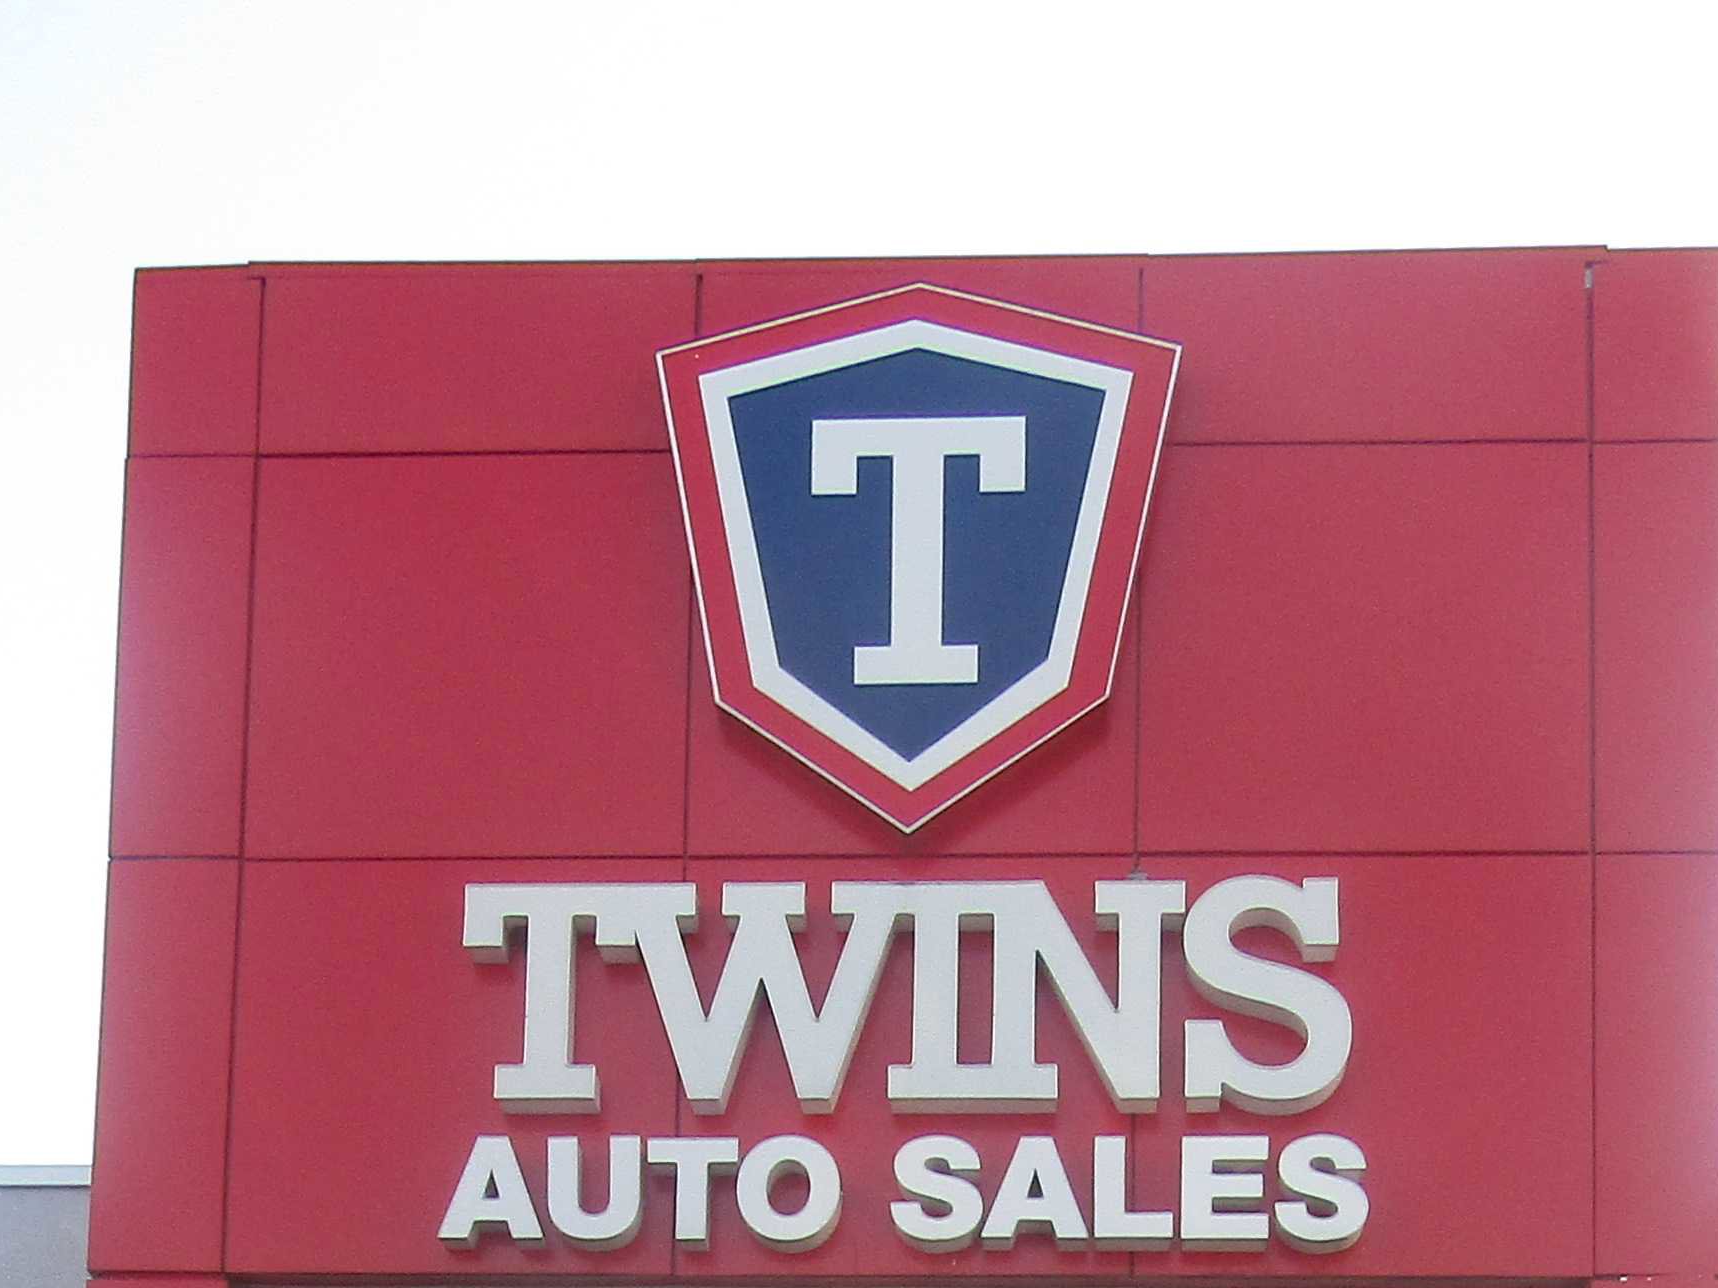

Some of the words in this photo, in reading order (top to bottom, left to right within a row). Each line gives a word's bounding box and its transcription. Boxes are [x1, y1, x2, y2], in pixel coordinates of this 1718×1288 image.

[810, 415, 1028, 687] T
[461, 875, 1353, 1117] TWINS
[440, 1134, 842, 1252] AUTO
[890, 1134, 1371, 1253] SALES
